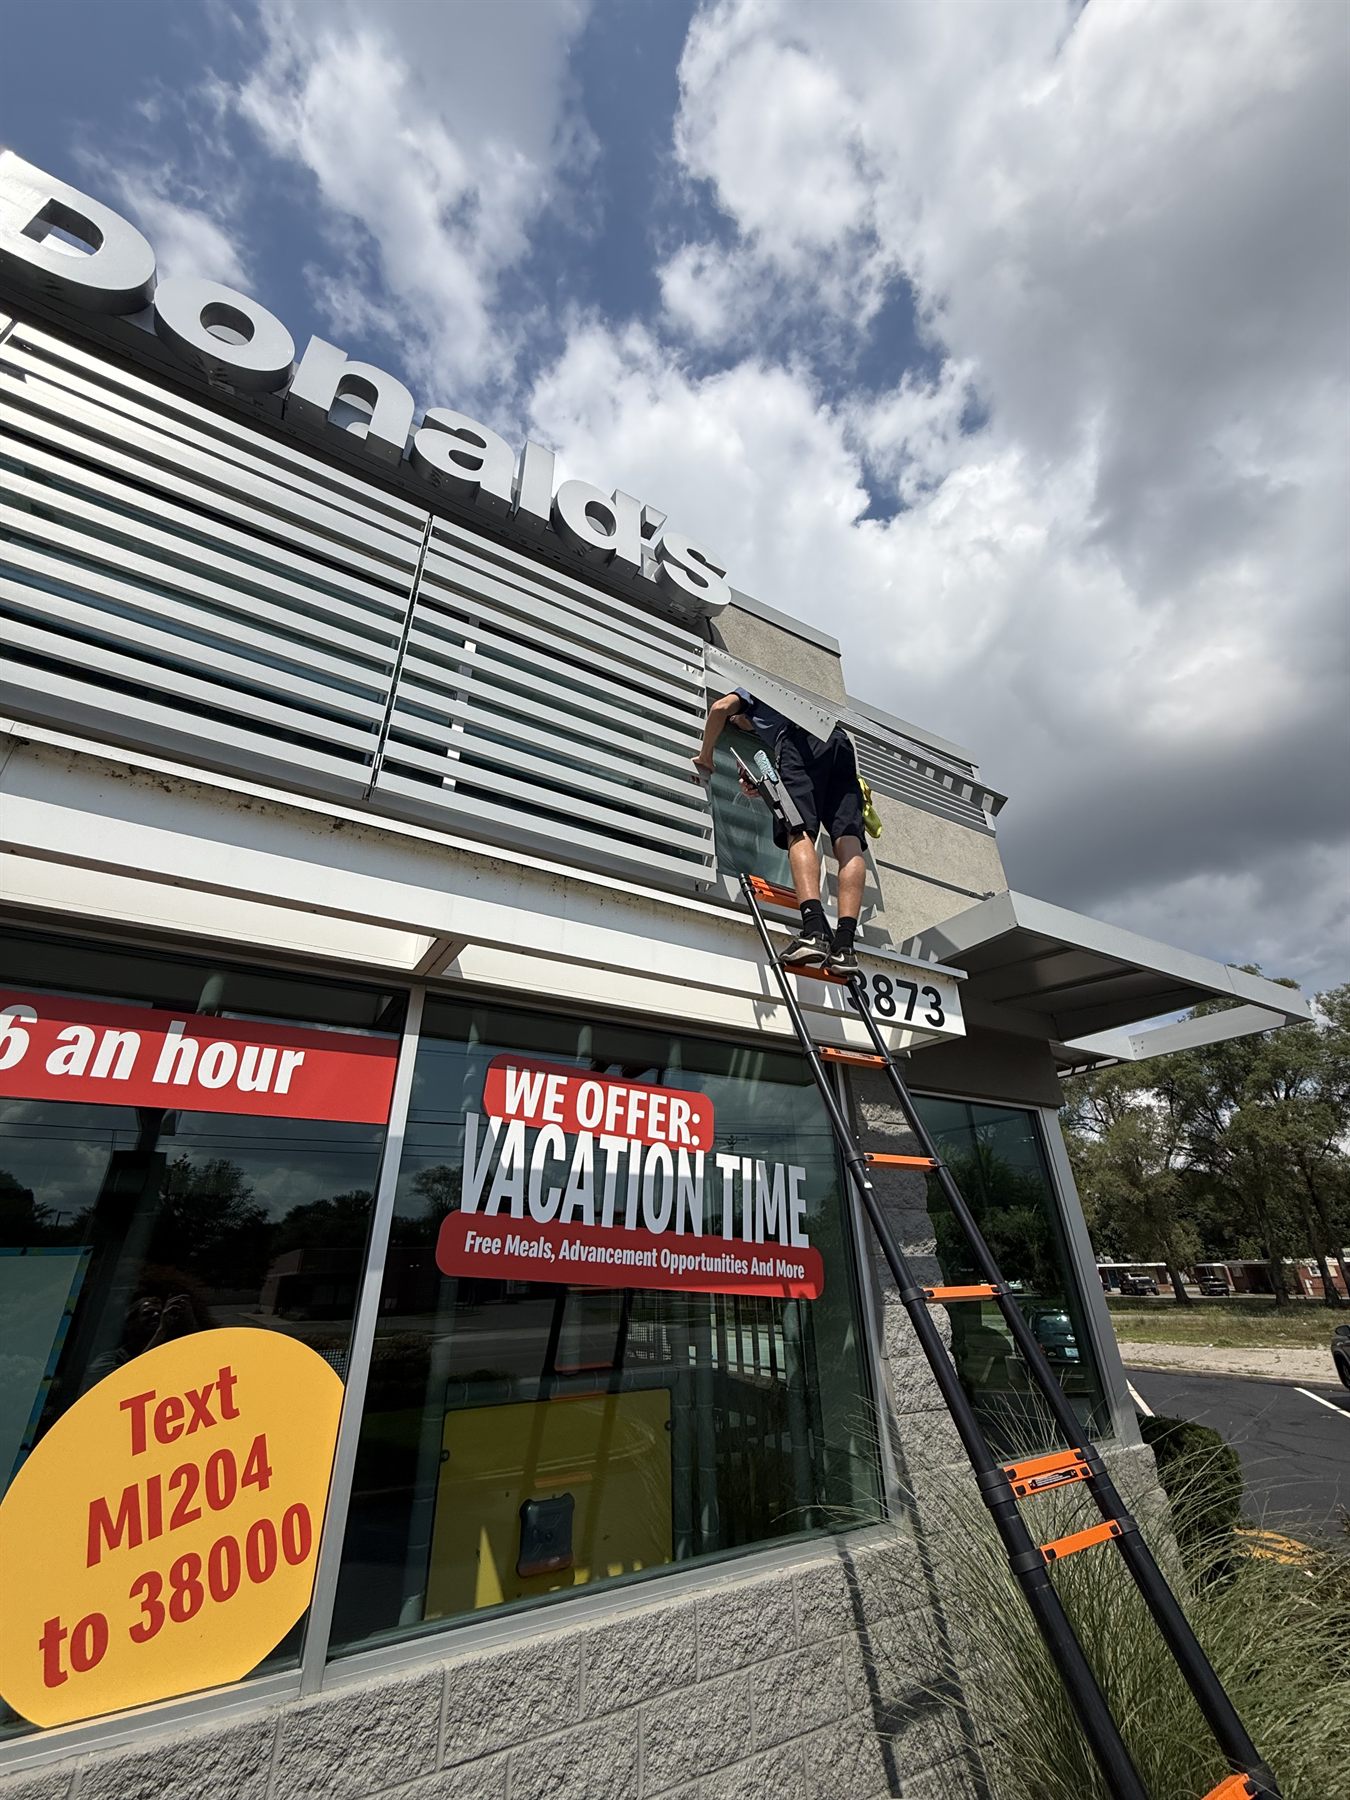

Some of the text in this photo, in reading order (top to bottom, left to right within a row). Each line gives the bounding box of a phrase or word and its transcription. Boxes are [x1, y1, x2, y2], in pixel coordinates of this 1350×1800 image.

[0, 150, 731, 616] Donald's
[45, 1025, 141, 1080] an
[152, 1020, 305, 1094] hour
[505, 1065, 701, 1146] WE OFFER:
[460, 1111, 810, 1249] VACATION TIME
[464, 1230, 805, 1279] Free Meals, Advancement Opportunities And More
[120, 1366, 240, 1456] Text
[85, 1433, 274, 1568] MI204
[39, 1502, 313, 1688] to 38000
